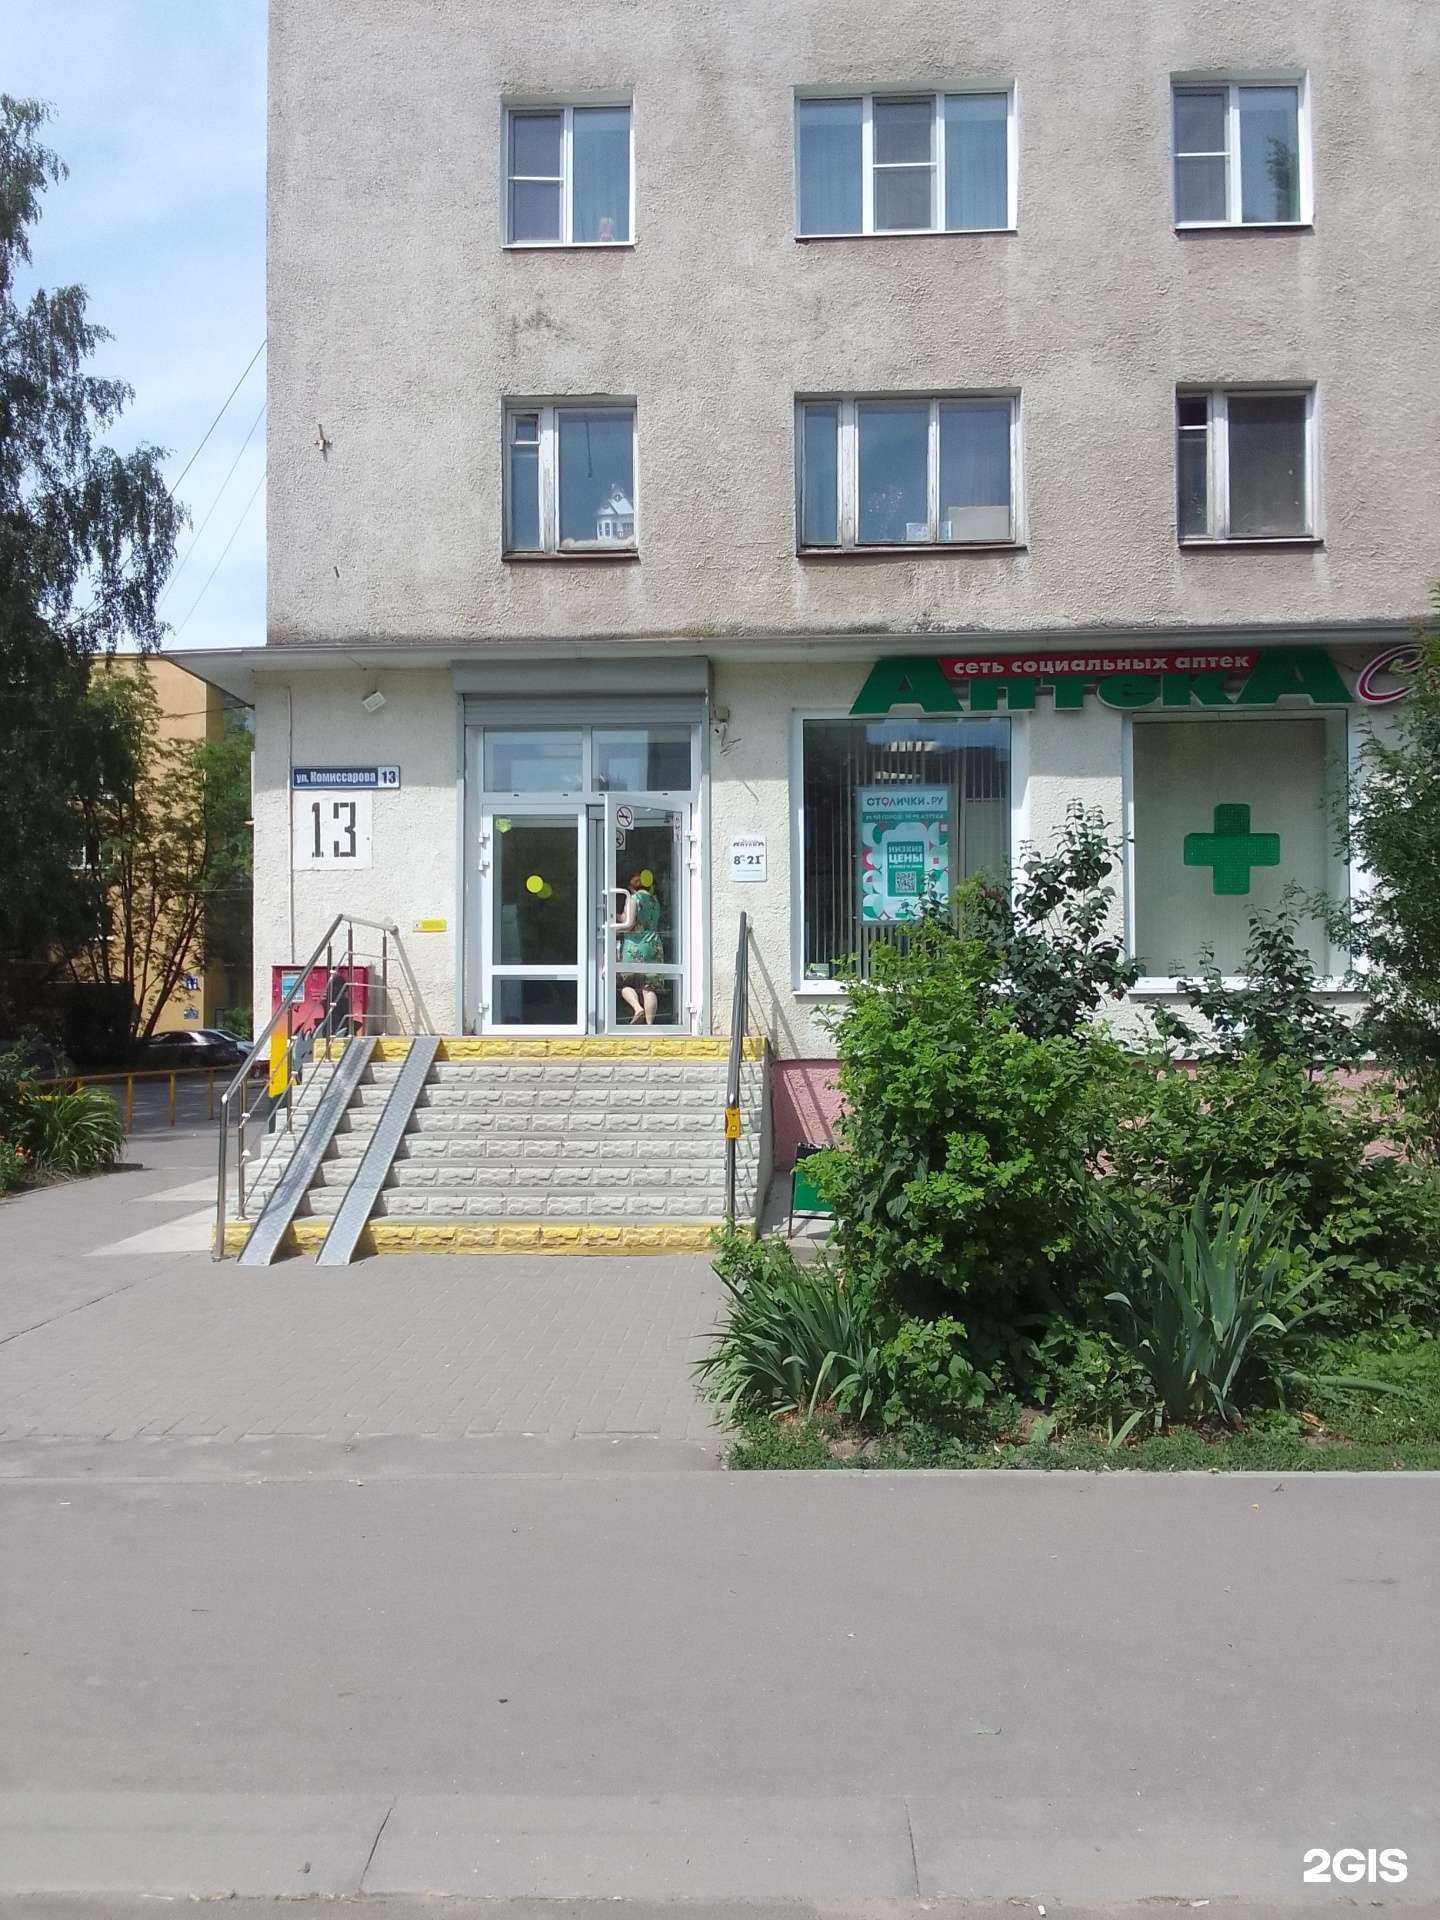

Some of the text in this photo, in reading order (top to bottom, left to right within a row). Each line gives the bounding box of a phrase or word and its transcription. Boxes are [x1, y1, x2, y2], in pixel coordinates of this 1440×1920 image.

[954, 654, 1249, 675] сеть социальных аптек
[296, 770, 396, 783] ул. Комиссарова 13
[311, 801, 356, 857] 13
[888, 853, 923, 864] ЦЕНЫ
